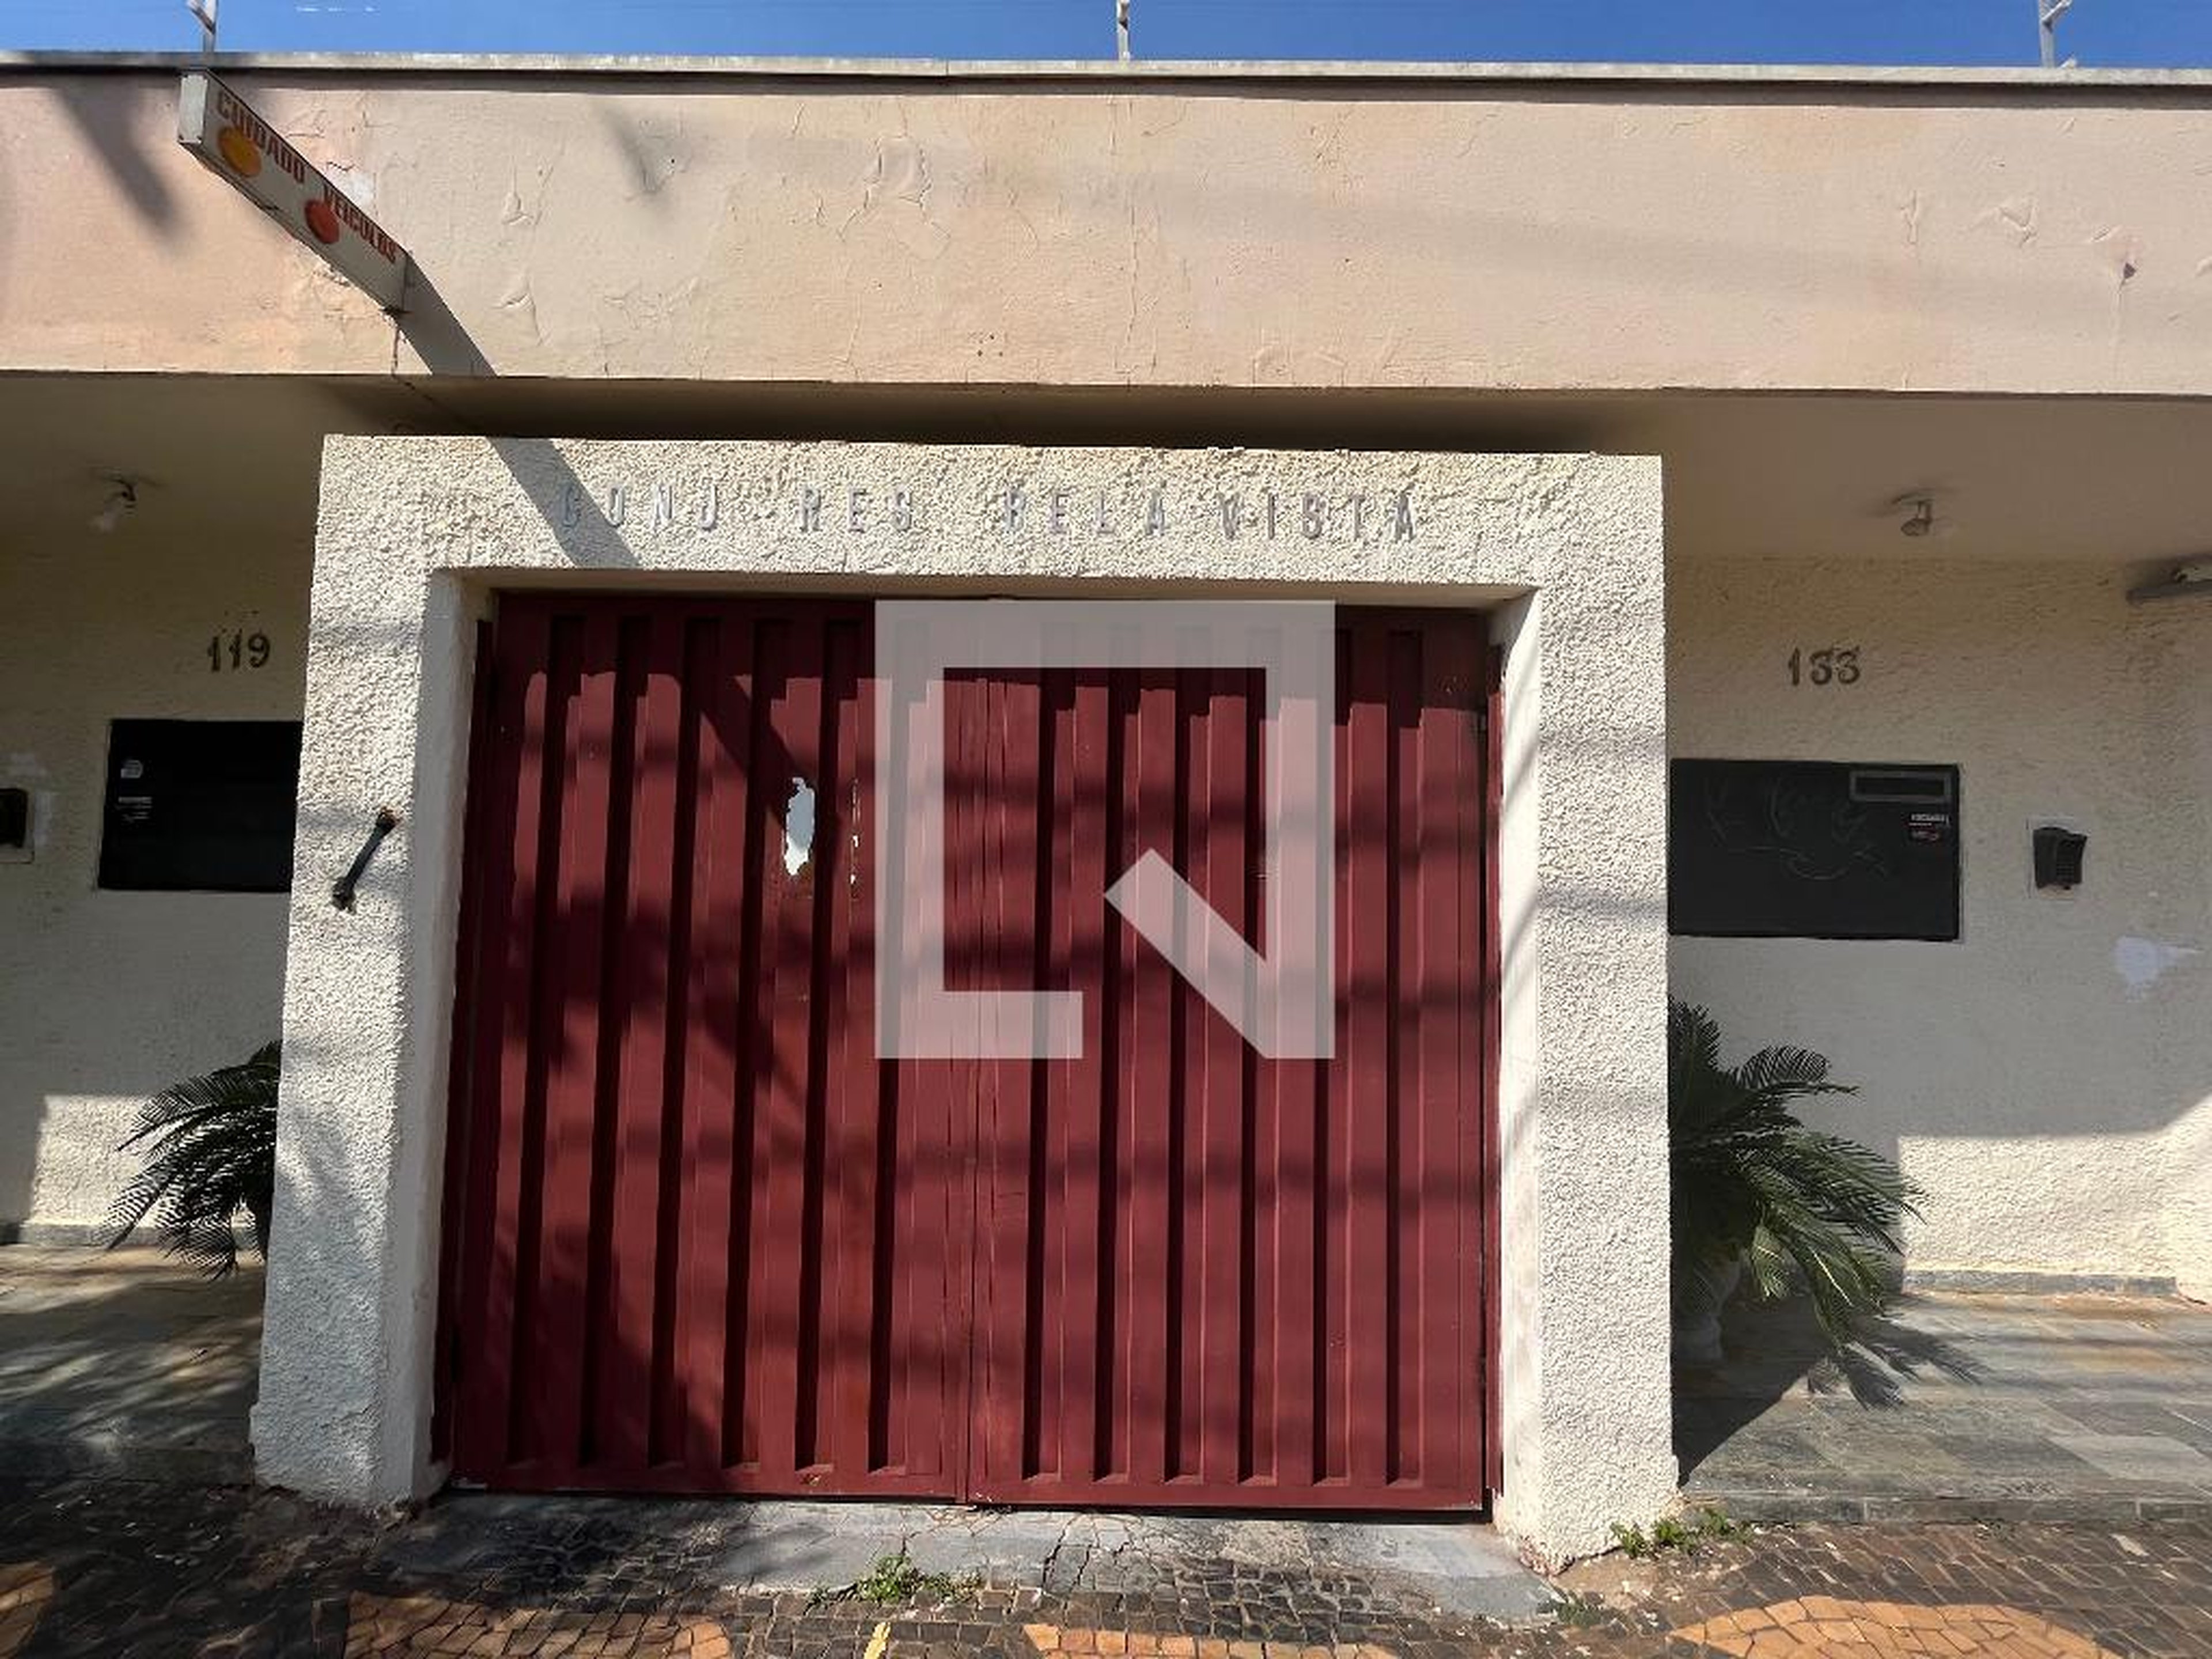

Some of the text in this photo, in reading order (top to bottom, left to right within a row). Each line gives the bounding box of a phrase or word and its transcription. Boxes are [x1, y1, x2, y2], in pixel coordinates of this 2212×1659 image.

[218, 90, 396, 264] CUIDADO VEICULOS
[800, 484, 912, 533] RES
[1217, 487, 1416, 542] VISTA
[207, 630, 271, 672] 119
